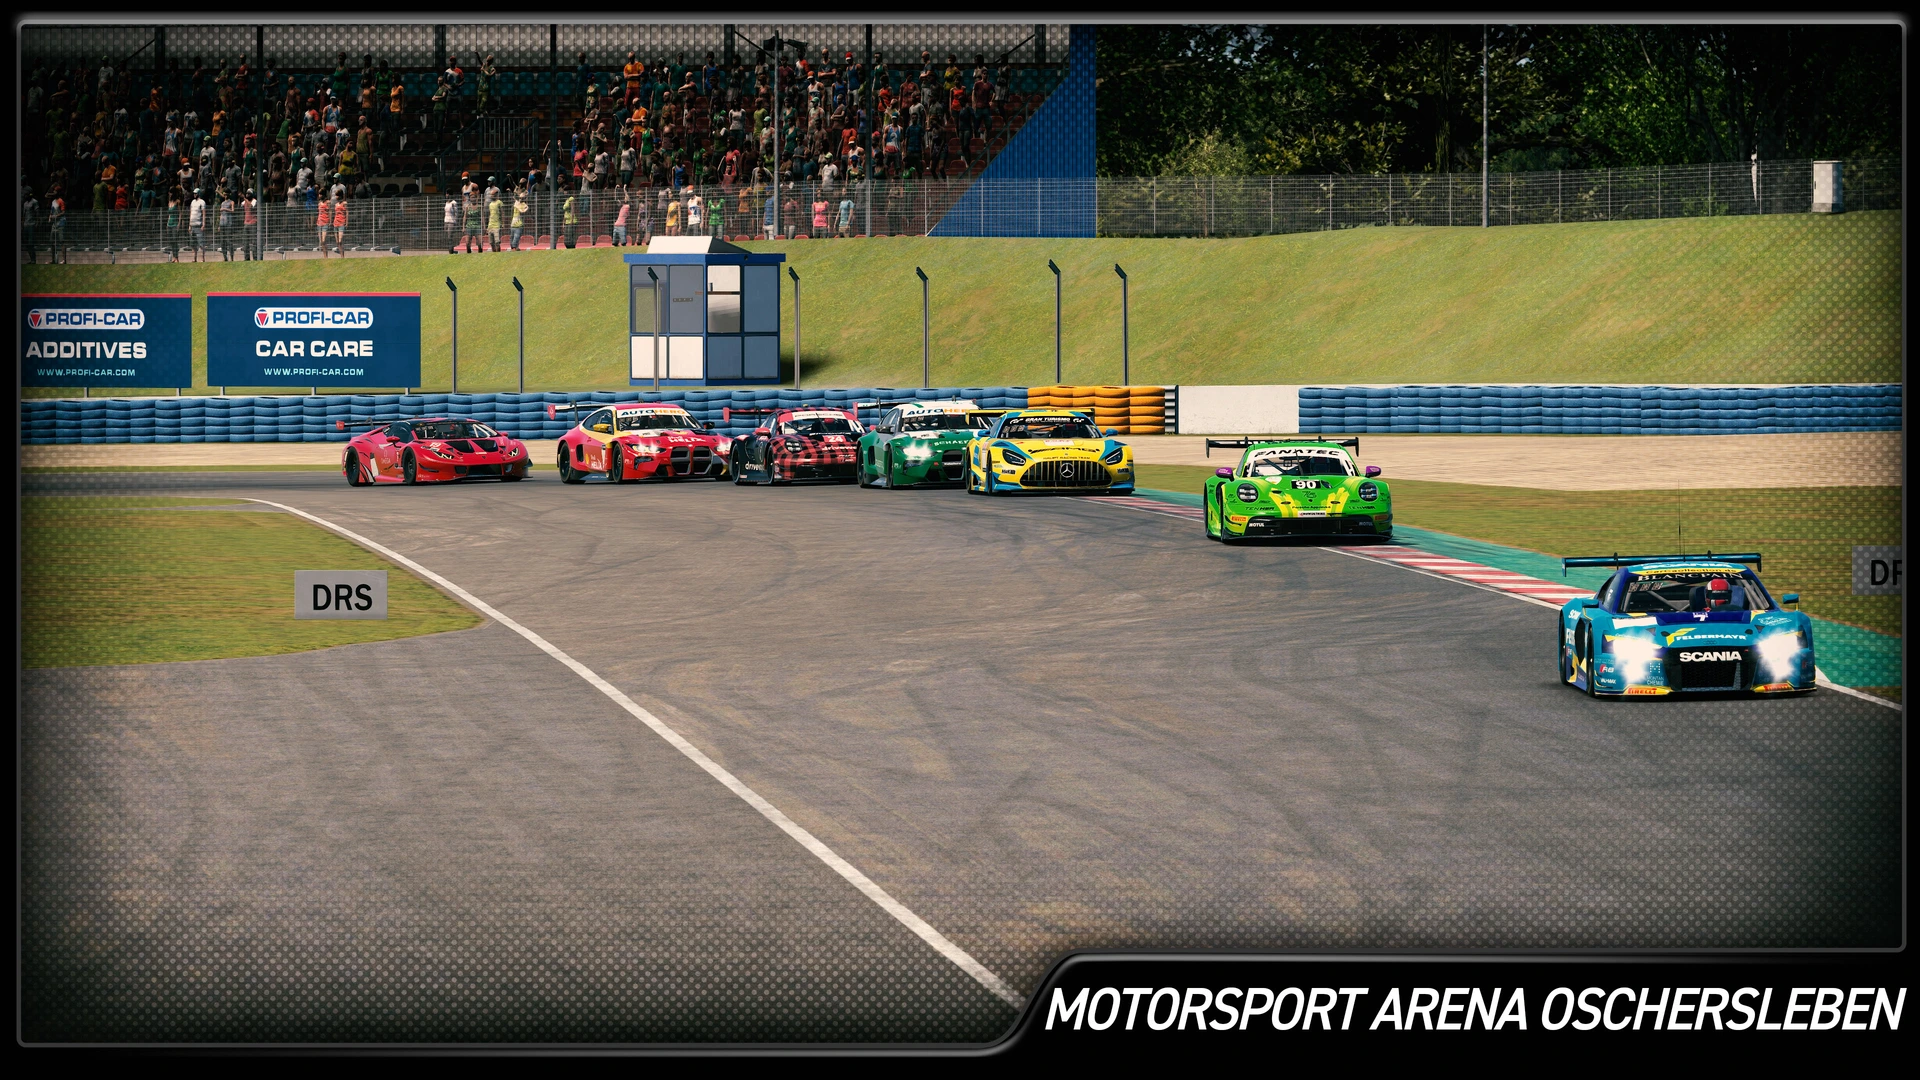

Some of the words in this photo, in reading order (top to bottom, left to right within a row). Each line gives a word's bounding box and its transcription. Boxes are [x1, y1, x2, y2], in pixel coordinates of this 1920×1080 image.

[45, 312, 142, 326] PROFI-CAR
[272, 311, 370, 325] PROFI-CAR
[25, 341, 148, 359] ADDITIVES
[255, 339, 305, 358] CAR
[309, 339, 374, 358] CARE
[36, 368, 137, 377] WWW.PROFI-CAR.COM
[263, 368, 365, 376] WWW.PROFI-CAR.COM
[1253, 448, 1341, 458] FANATEC
[1294, 480, 1318, 490] 90
[1637, 572, 1744, 582] BLANCPAIN
[312, 583, 373, 611] DRS
[1679, 650, 1743, 662] SCANIA
